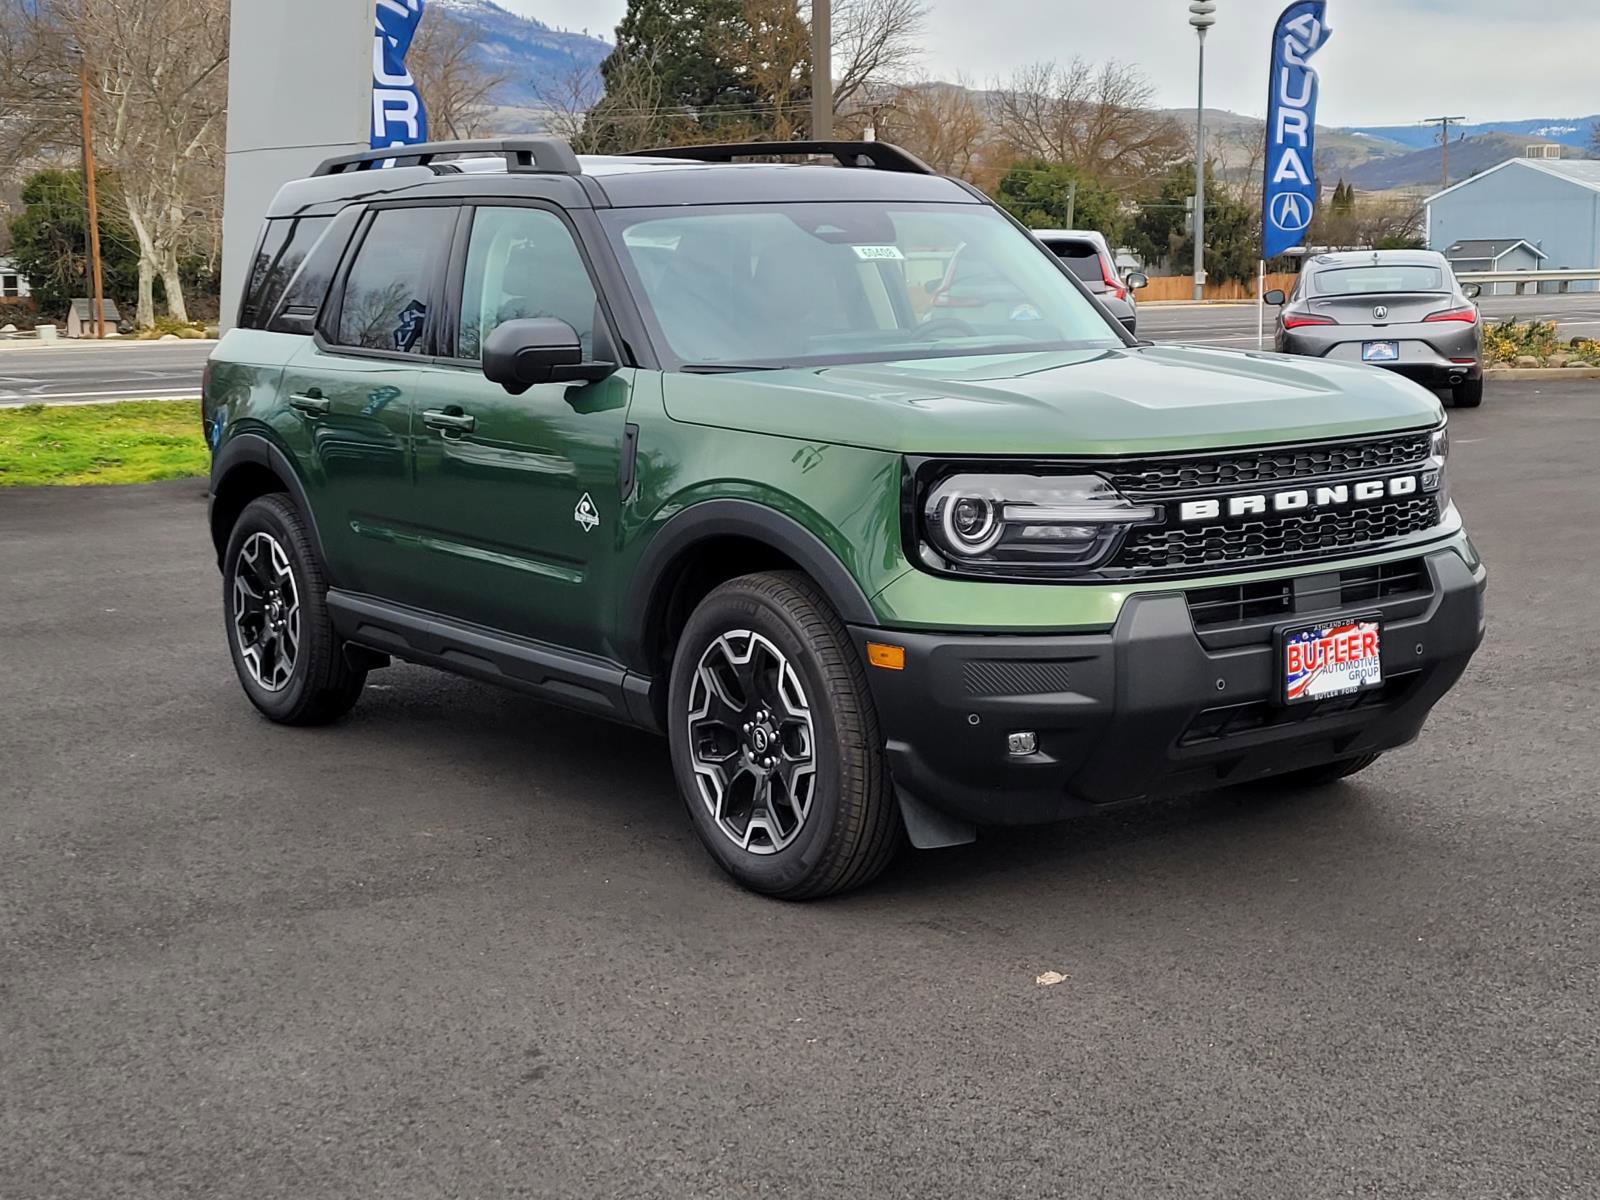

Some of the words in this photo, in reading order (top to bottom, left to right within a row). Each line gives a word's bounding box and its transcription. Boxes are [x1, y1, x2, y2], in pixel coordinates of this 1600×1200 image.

[1273, 12, 1321, 185] ACURA
[1180, 475, 1417, 520] BRONCO
[1287, 631, 1378, 675] BUTLER
[1322, 656, 1379, 675] AUTOMOTIVE
[1348, 667, 1379, 681] GROUP
